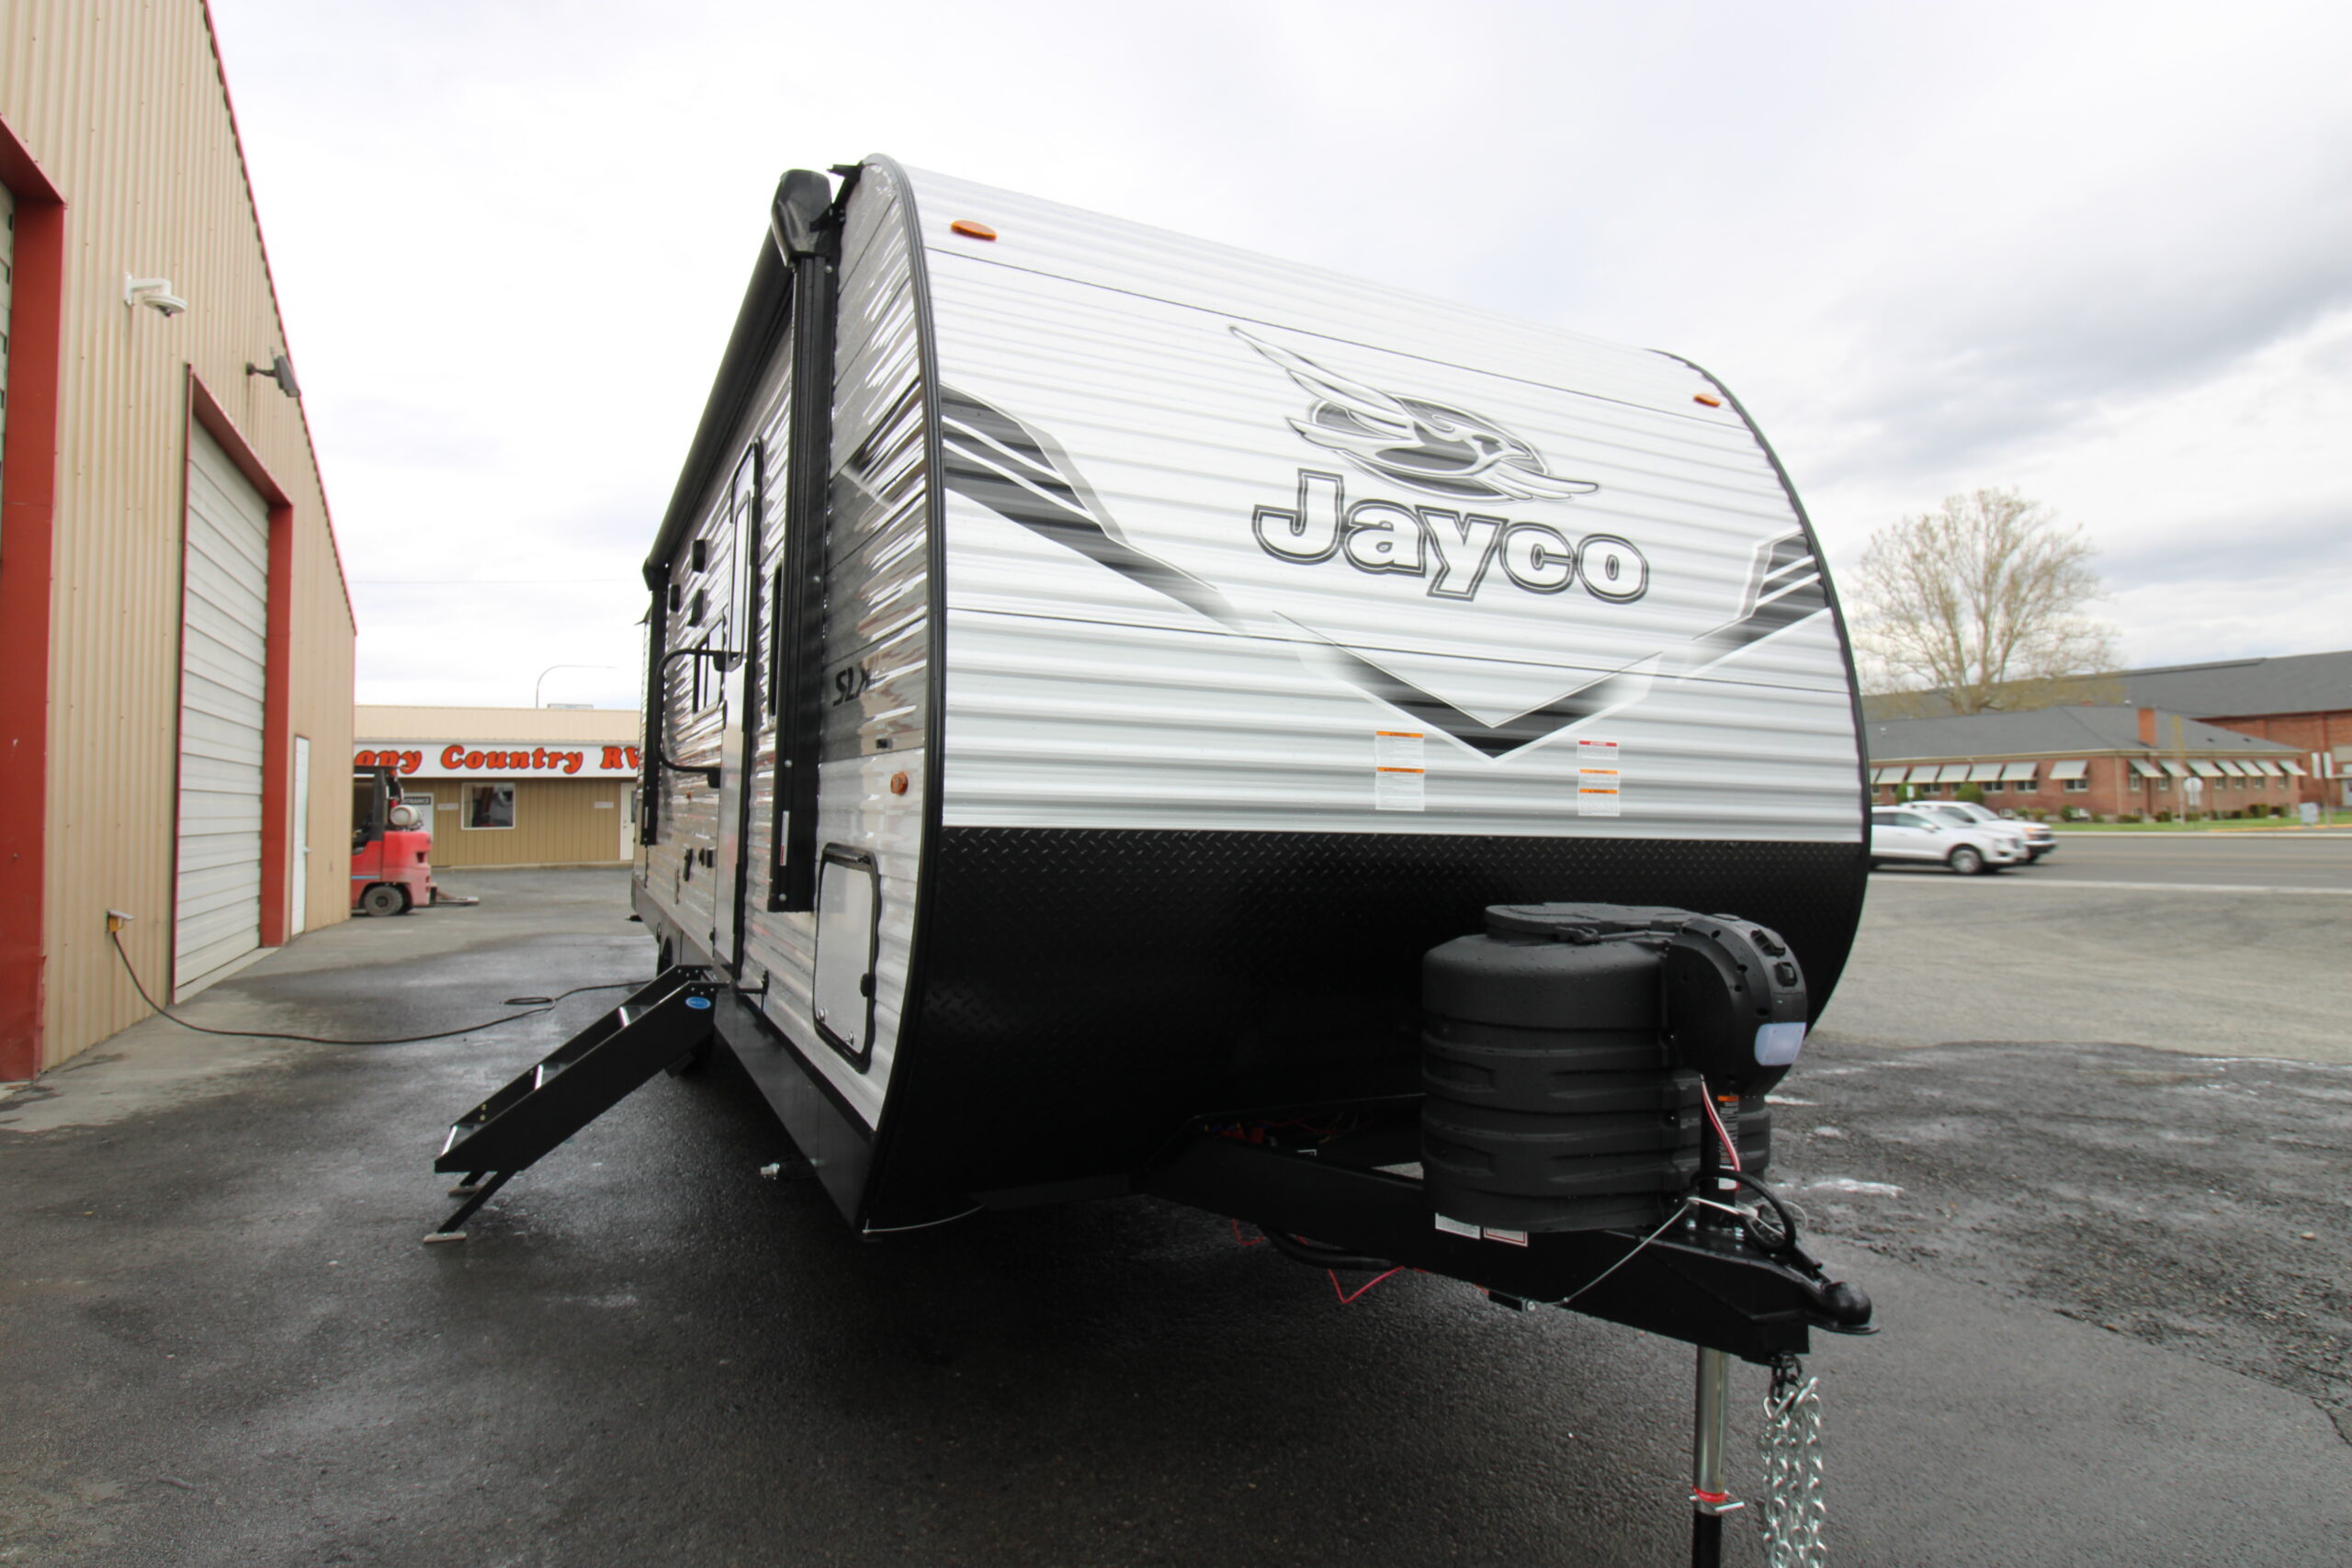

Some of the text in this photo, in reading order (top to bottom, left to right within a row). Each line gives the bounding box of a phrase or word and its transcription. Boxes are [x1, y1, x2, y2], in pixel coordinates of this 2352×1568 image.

[1251, 467, 1649, 604] Jayco
[833, 661, 878, 706] SLX
[440, 745, 583, 774] Country
[600, 747, 639, 770] RV
